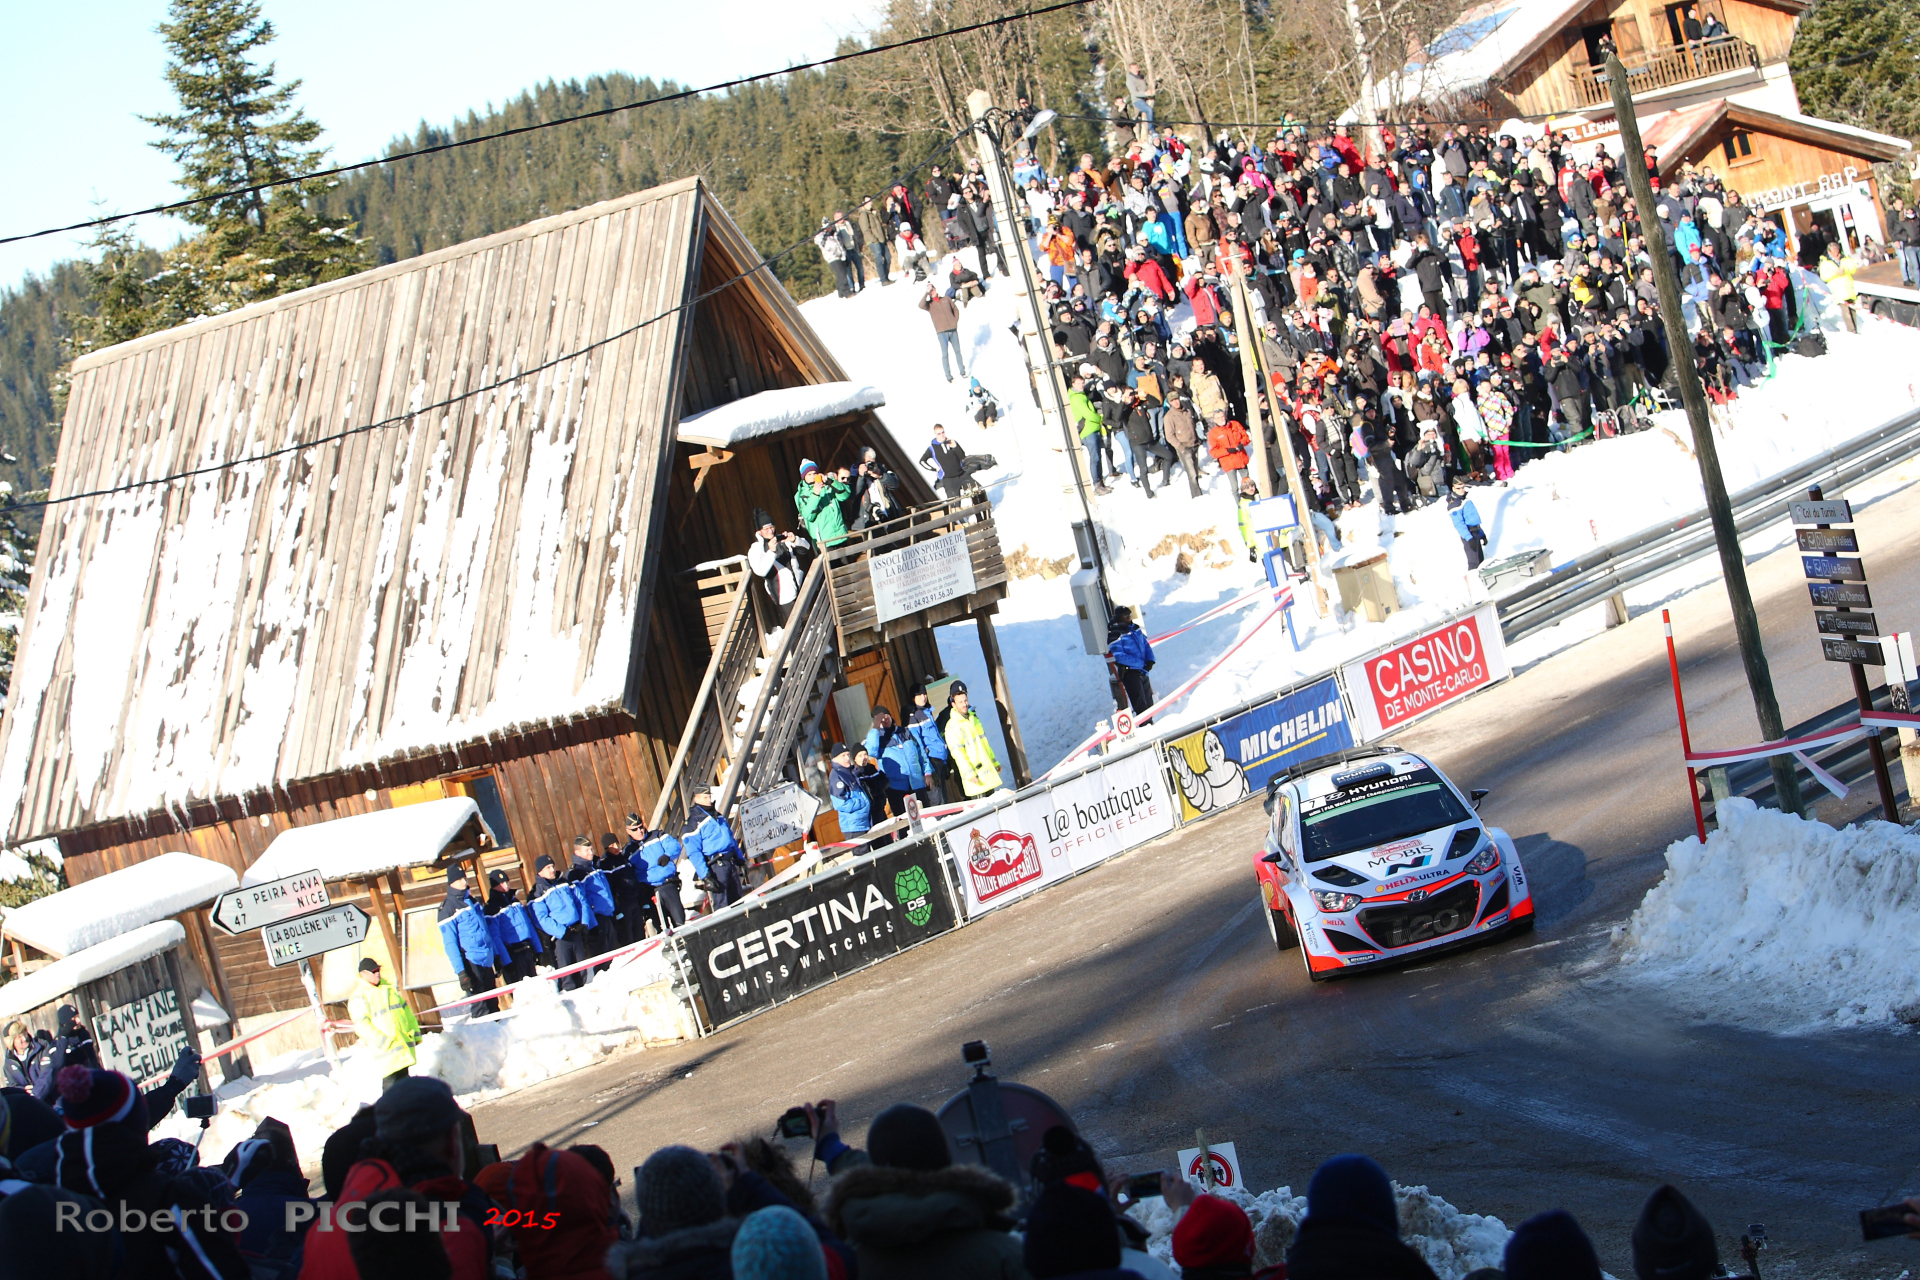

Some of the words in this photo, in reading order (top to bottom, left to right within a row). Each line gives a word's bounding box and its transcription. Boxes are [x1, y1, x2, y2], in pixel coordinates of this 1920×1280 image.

[1802, 507, 1812, 518] Col
[1812, 507, 1820, 518] du
[1820, 506, 1836, 518] Turini
[873, 546, 920, 572] ASSOCIATION
[921, 534, 954, 556] SPORTIVE
[954, 532, 964, 544] DE
[1824, 536, 1833, 546] Les
[885, 567, 896, 578] LA
[897, 545, 958, 574] BOLLENE-VESUBIE
[1830, 564, 1837, 574] Le
[1837, 563, 1852, 574] Ranch
[903, 602, 914, 612] Tél.
[914, 588, 954, 608] 04.93.91.56.30
[1837, 592, 1846, 601] Les
[1846, 591, 1866, 602] Chamois
[1375, 623, 1476, 699] CASINO
[1384, 701, 1406, 722] DE
[1404, 662, 1483, 717] MONTE-CARLO
[1240, 698, 1344, 764] MICHELIN
[1334, 799, 1351, 807] World
[1366, 785, 1405, 798] Championship
[1349, 774, 1412, 795] HYUNDAI
[744, 814, 763, 831] CIRCUIT
[768, 801, 798, 820] L'AUTHION
[1042, 808, 1070, 844] L@
[1072, 781, 1153, 830] boutique
[1309, 800, 1315, 808] 7
[1050, 804, 1158, 858] OFFICIELLE
[1367, 844, 1434, 868] MOBIS
[973, 874, 999, 898] RALLYE
[996, 850, 1040, 889] MONTE-CARLO
[1385, 876, 1418, 890] HELIX
[1418, 869, 1450, 881] ULTRA
[234, 914, 247, 926] 47
[297, 890, 325, 908] NICE
[236, 898, 243, 909] 8
[253, 886, 288, 904] PEIRA
[292, 876, 320, 893] CAVA
[907, 896, 926, 910] DS
[270, 931, 282, 944] LA
[284, 920, 322, 940] BOLLÈNE
[343, 911, 354, 923] 12
[275, 942, 302, 959] NICE
[346, 926, 358, 938] 67
[708, 883, 894, 980] CERTINA
[723, 964, 790, 1003] SWISS
[800, 920, 894, 970] WATCHES
